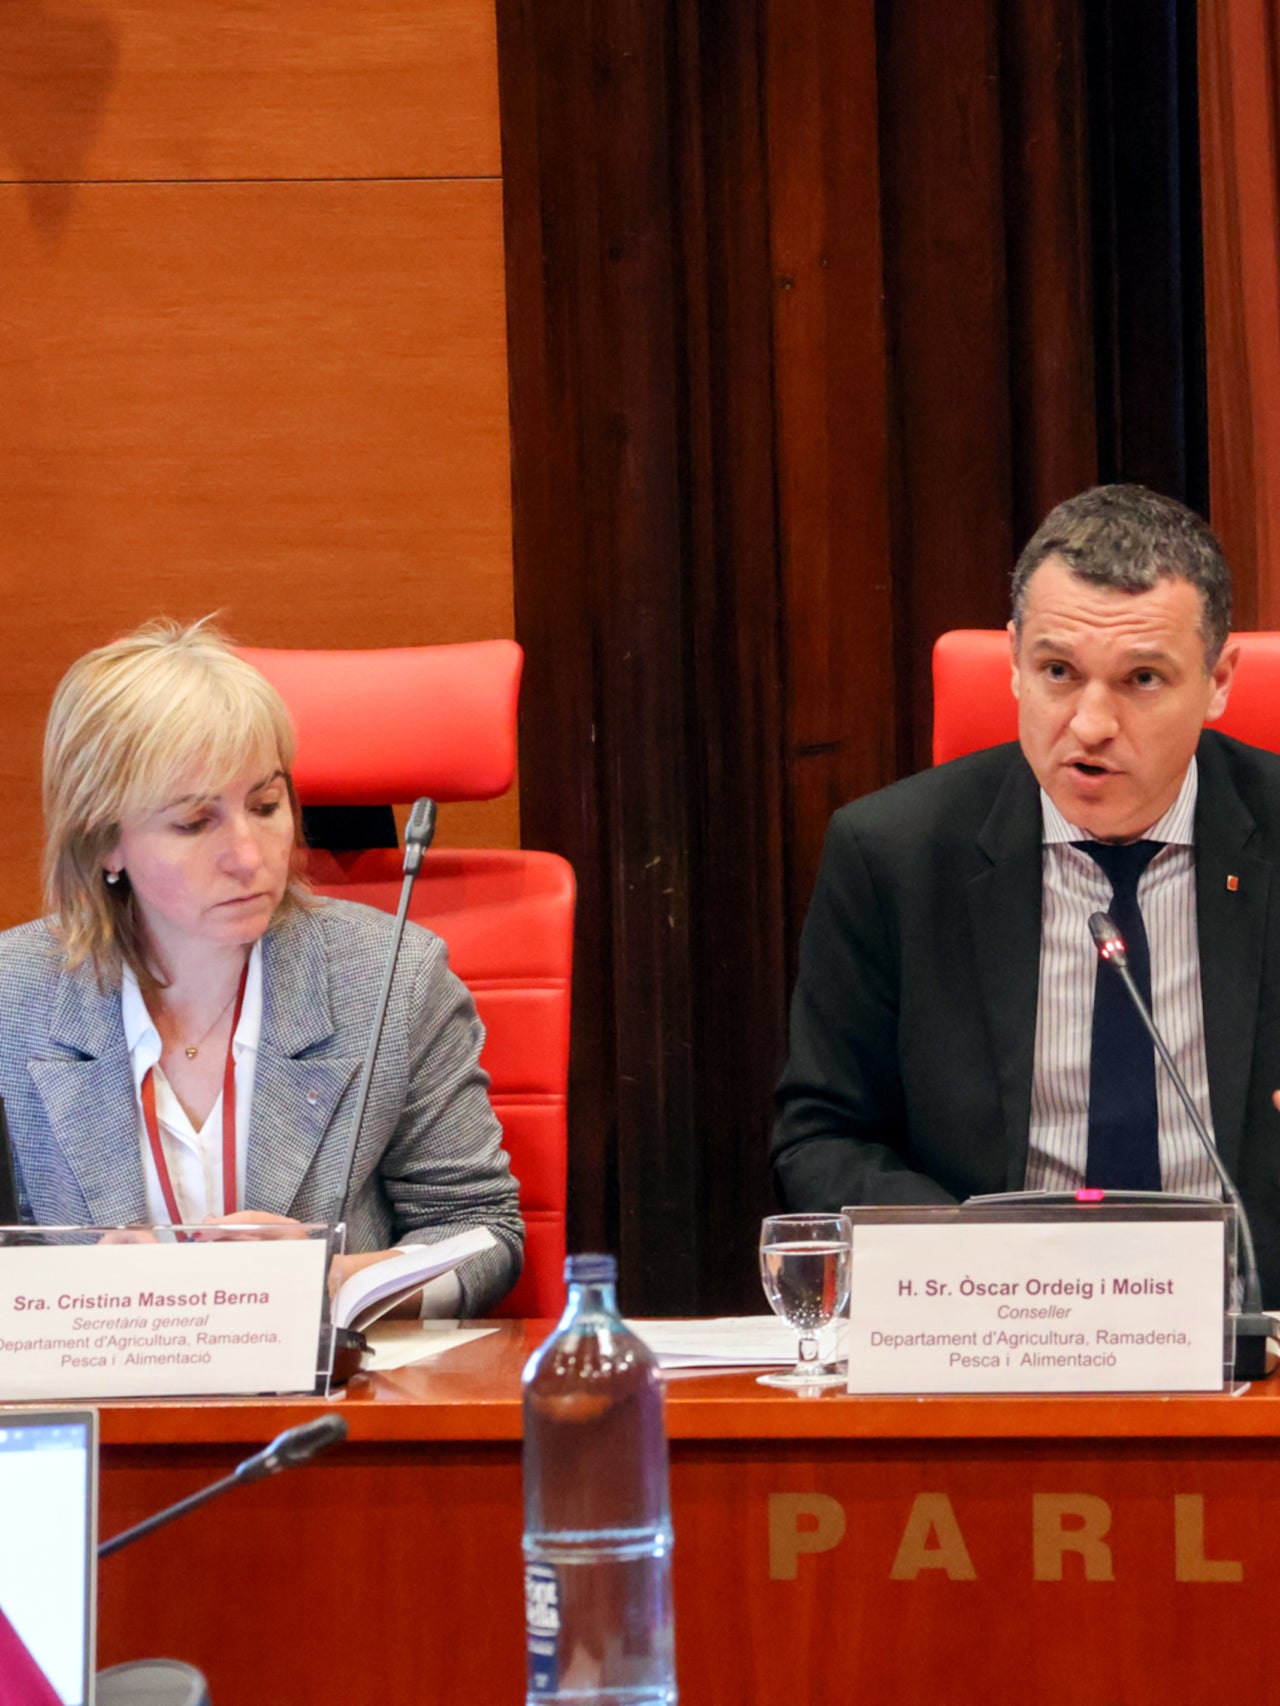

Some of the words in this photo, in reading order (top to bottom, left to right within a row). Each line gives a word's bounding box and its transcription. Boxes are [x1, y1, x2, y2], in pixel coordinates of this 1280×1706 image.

[898, 1279, 918, 1297] H.
[925, 1279, 953, 1297] Sr.
[959, 1274, 1020, 1297] Òscar
[1025, 1278, 1094, 1300] Ordeig
[1100, 1278, 1106, 1296] i
[1112, 1278, 1174, 1296] Molist
[13, 1295, 51, 1312] Sra.
[57, 1293, 132, 1310] Cristina
[138, 1291, 208, 1308] Massot
[213, 1289, 270, 1306] Berna
[996, 1304, 1072, 1320] Conseller
[72, 1315, 148, 1332] Secretària
[151, 1314, 210, 1333] general
[94, 1332, 191, 1352] d'Agricultura,
[870, 1331, 978, 1350] Departament
[982, 1330, 1090, 1350] d'Agricultura,
[1095, 1329, 1192, 1348] Ramaderia,
[60, 1354, 107, 1369] Pesca
[111, 1353, 117, 1367] i
[124, 1350, 212, 1367] Alimentació
[948, 1352, 1001, 1368] Pesca
[1006, 1352, 1011, 1367] i
[1020, 1350, 1117, 1368] Alimentació
